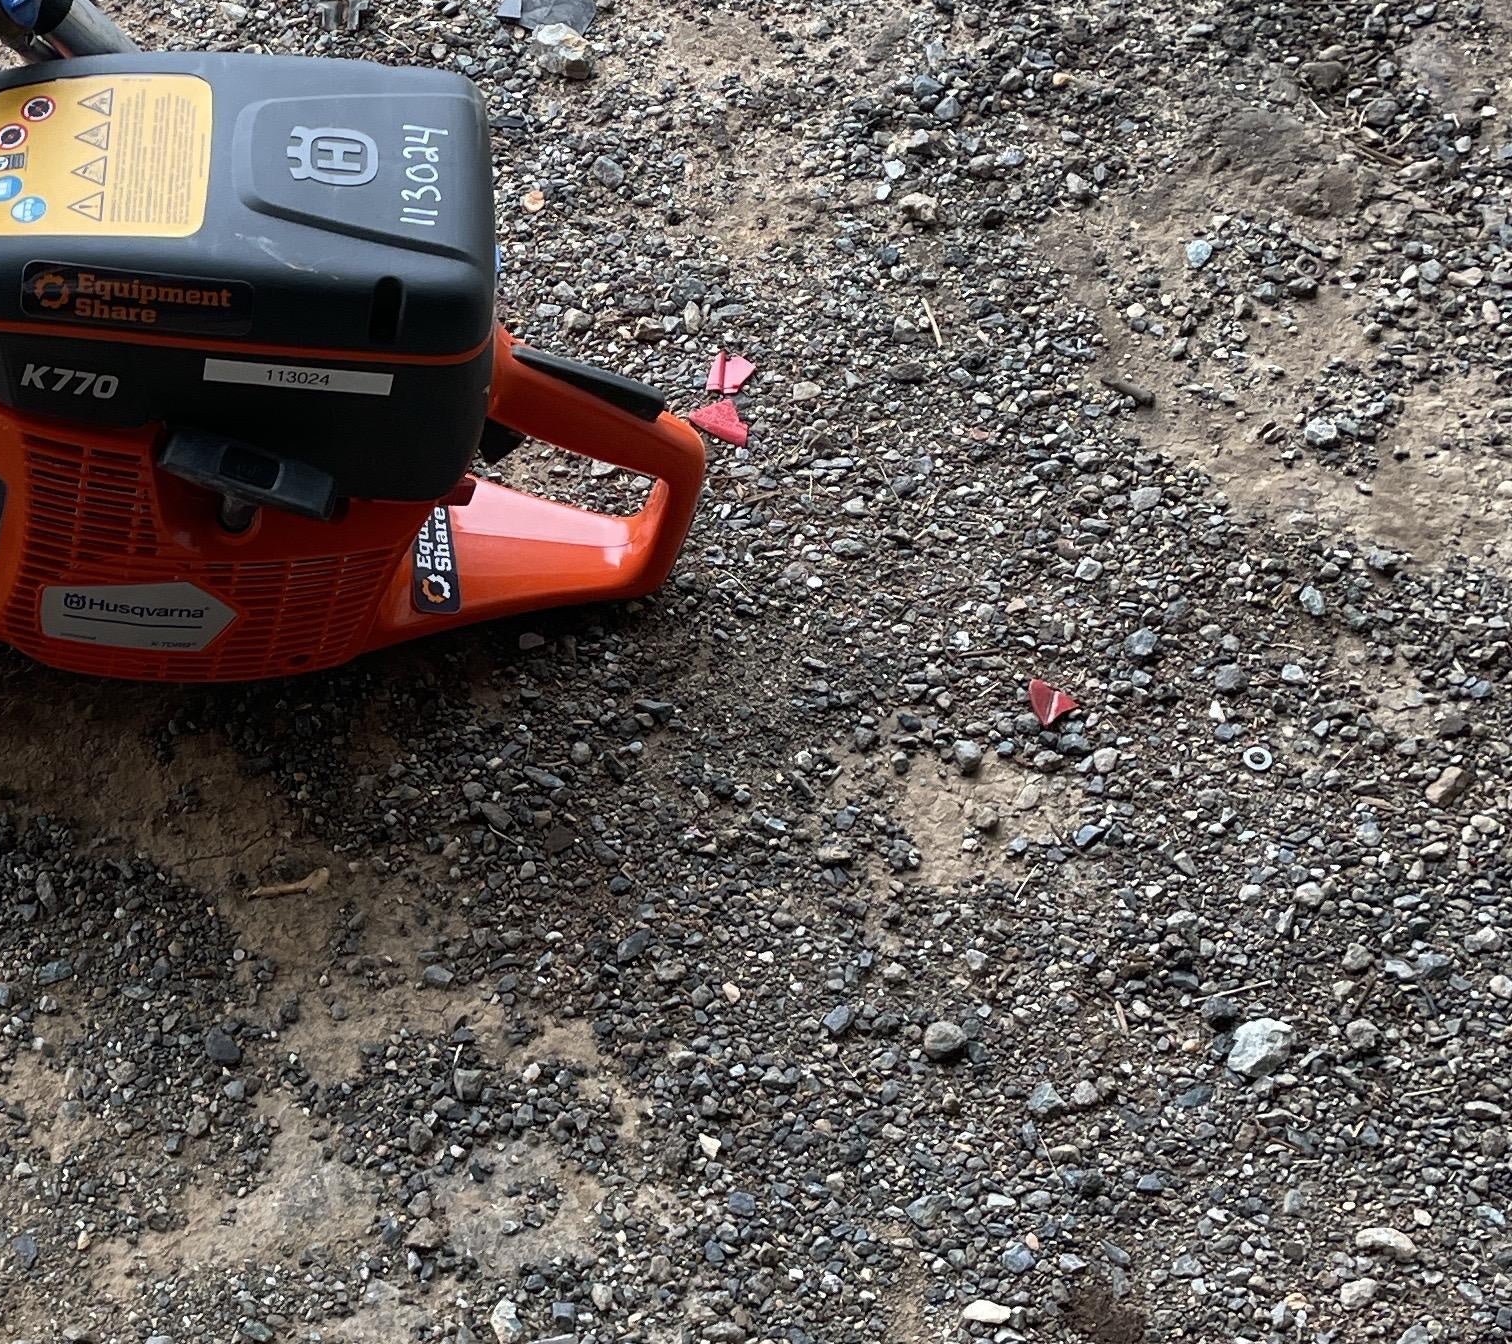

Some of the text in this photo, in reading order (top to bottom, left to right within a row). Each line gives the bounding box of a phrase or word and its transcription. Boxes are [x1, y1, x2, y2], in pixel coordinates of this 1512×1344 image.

[399, 123, 449, 226] 113024
[75, 272, 233, 308] Equipment
[74, 298, 158, 324] Share
[20, 362, 120, 400] K770
[265, 369, 331, 387] 113024
[433, 506, 452, 572] Share
[88, 597, 206, 619] Husqvarna
